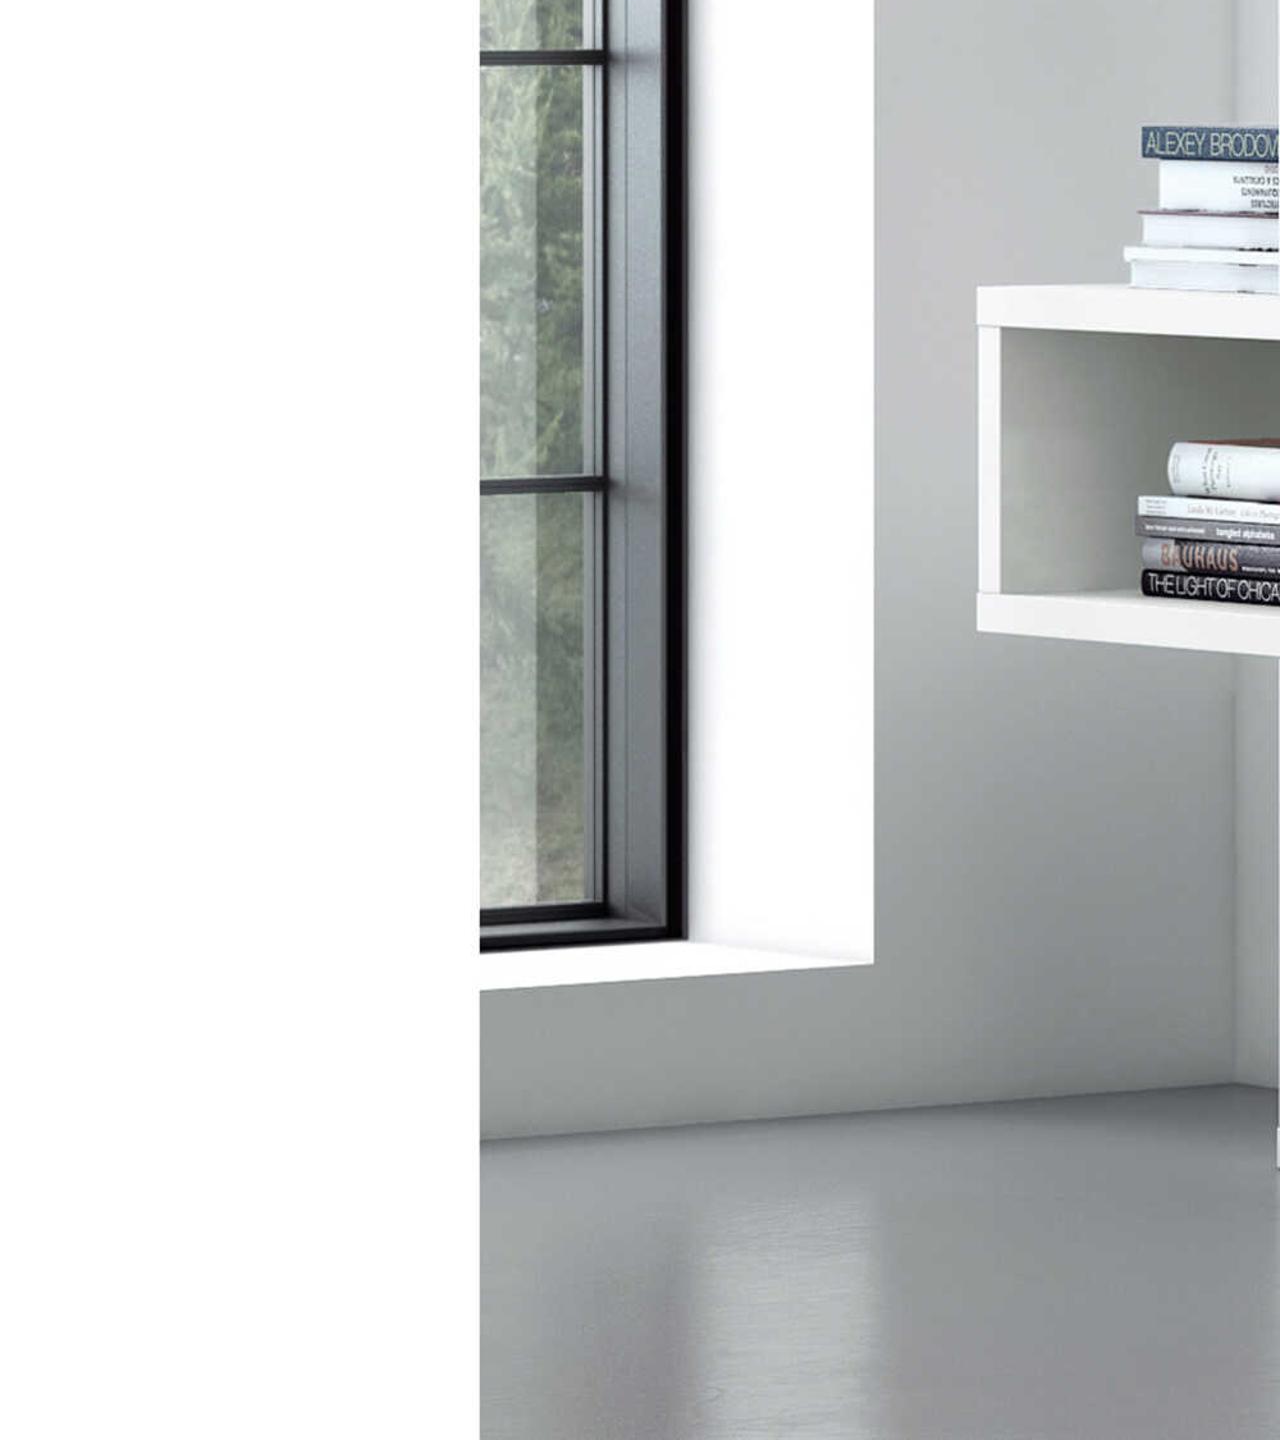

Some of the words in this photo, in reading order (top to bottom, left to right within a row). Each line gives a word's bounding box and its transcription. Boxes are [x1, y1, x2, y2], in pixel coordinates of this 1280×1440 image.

[1145, 131, 1206, 155] ALEXEY
[1160, 543, 1239, 572] BAUHAUS
[1147, 572, 1174, 595] THE
[1175, 575, 1214, 597] LIGHT
[1215, 577, 1237, 598] OF
